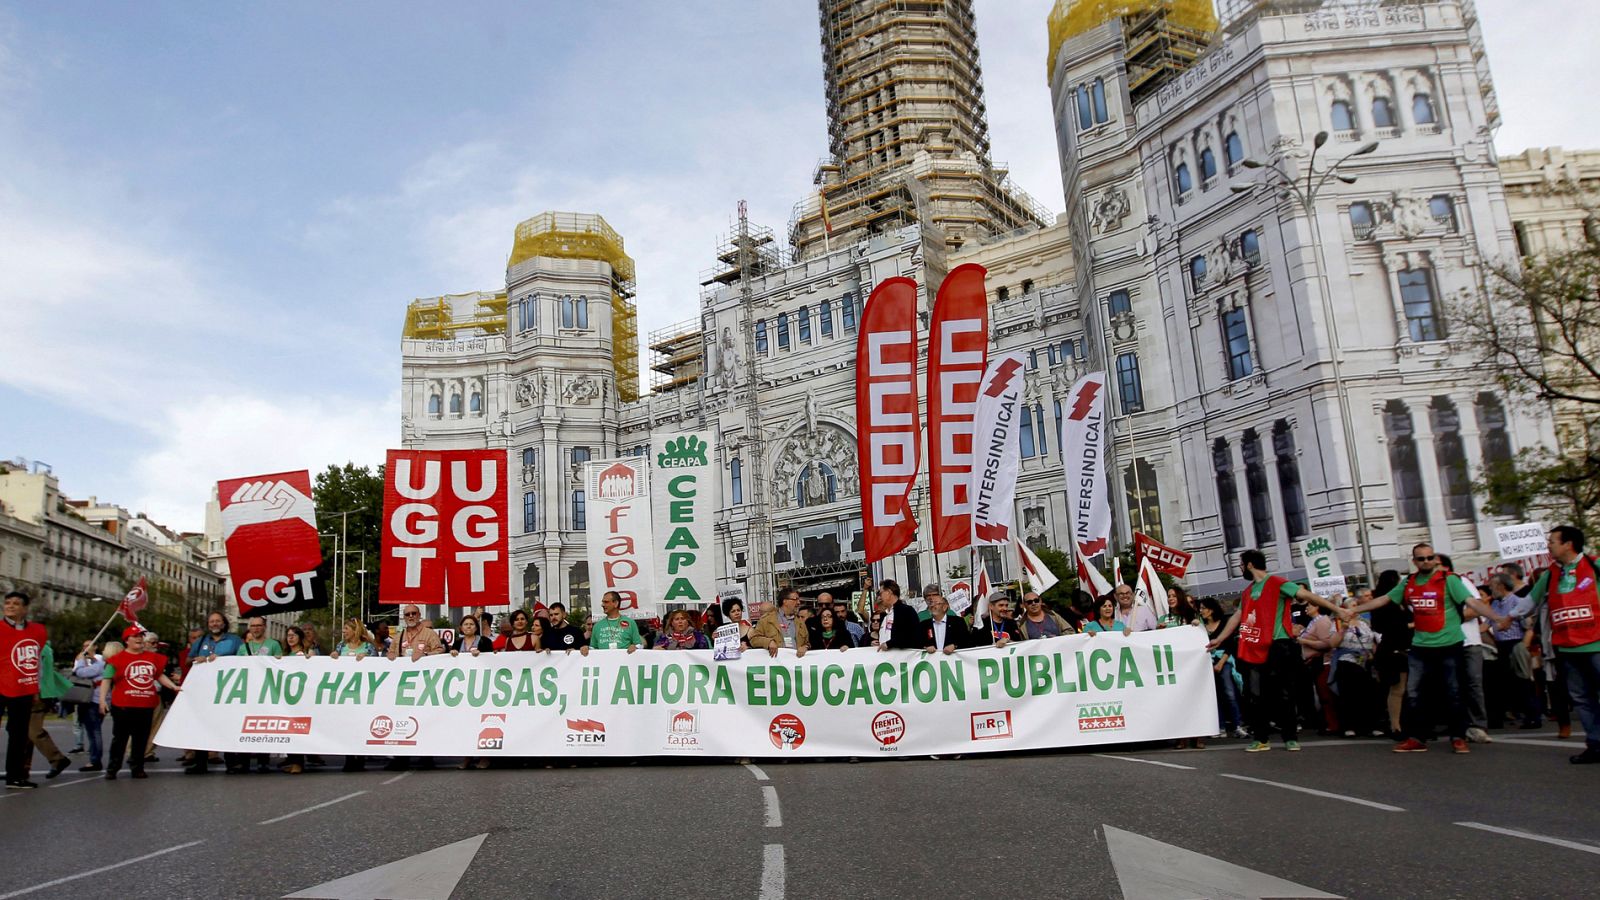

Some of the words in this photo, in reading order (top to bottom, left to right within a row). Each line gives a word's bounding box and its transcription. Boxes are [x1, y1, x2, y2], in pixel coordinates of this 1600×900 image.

[662, 457, 701, 467] CEAPA
[976, 392, 1018, 520] INTERSINDICAL
[1078, 411, 1102, 538] INTERSINDICAL
[391, 459, 440, 588] UGT
[452, 460, 499, 592] UGT
[664, 474, 700, 601] CEAPA
[1499, 531, 1509, 541] SIN
[1503, 545, 1512, 555] NO
[1513, 544, 1525, 553] HAY
[240, 570, 317, 606] CGT
[1552, 607, 1591, 622] CCOO
[17, 646, 38, 661] UGT
[130, 665, 154, 679] UGT
[213, 668, 248, 704] YA
[258, 667, 308, 705] NO
[315, 671, 389, 704] HAY
[395, 667, 567, 715] EXCUSAS,
[610, 664, 735, 704] AHORA
[746, 651, 966, 707] EDUCACIÓN
[978, 647, 1144, 700] PÚBLICA
[245, 719, 290, 730] CCOO
[372, 719, 392, 729] UGT
[875, 717, 900, 729] FRENTE
[239, 734, 291, 743] enseñanza
[479, 738, 503, 748] CGT
[566, 734, 605, 743] STEM
